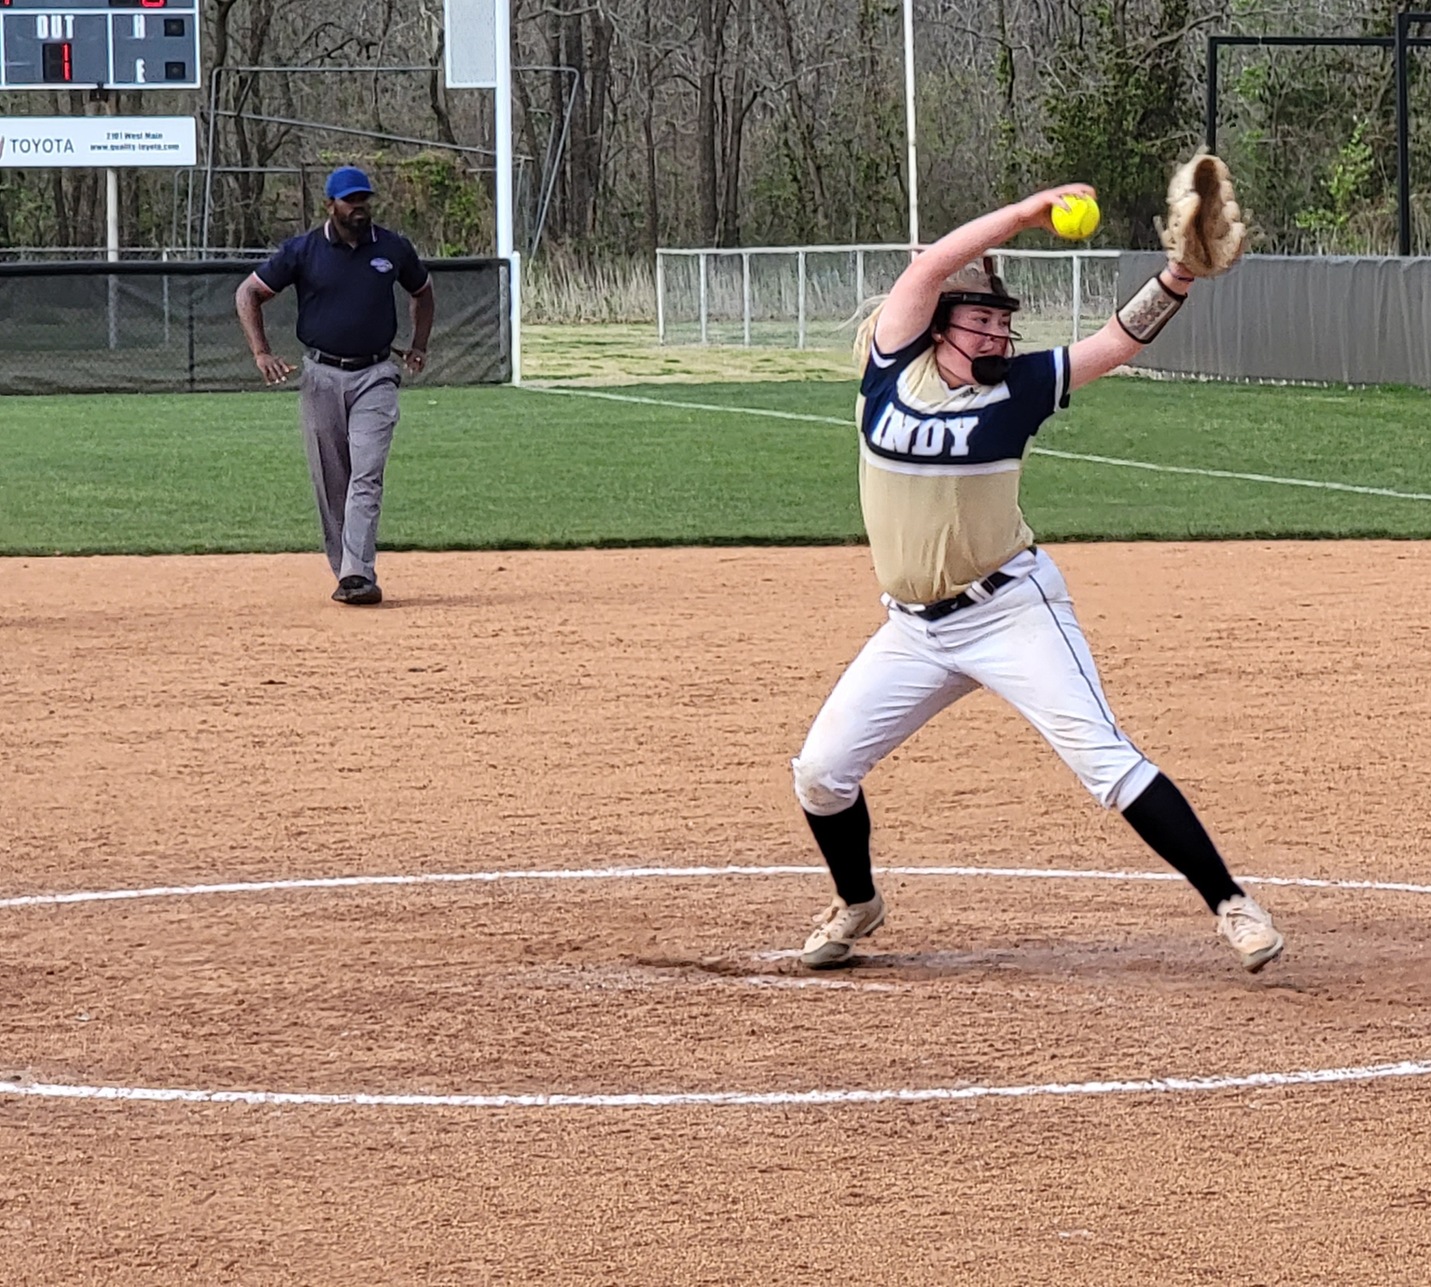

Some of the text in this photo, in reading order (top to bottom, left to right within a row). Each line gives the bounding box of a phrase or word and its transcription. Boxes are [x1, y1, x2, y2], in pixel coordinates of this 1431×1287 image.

[36, 14, 75, 40] OUT
[136, 58, 146, 84] E
[10, 138, 75, 154] TOYOTA
[124, 132, 143, 140] West
[145, 132, 163, 140] Main
[871, 401, 979, 457] INDY
